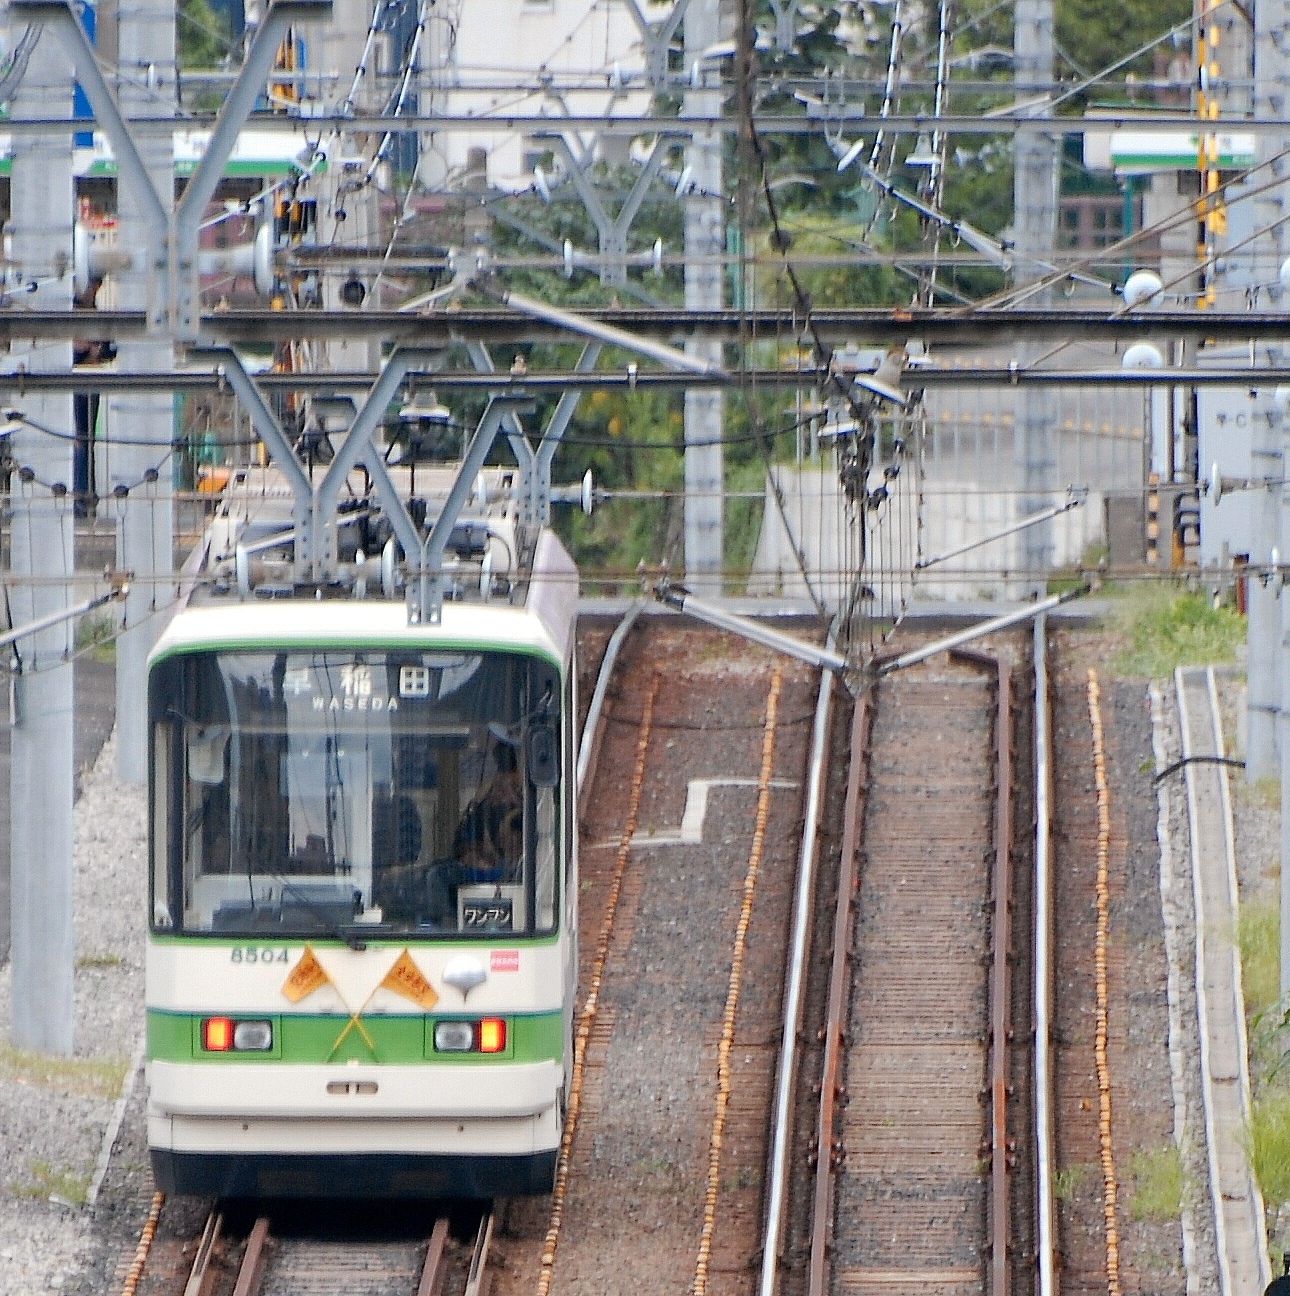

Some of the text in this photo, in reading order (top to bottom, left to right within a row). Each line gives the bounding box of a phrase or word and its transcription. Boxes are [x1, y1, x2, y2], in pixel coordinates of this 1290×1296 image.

[282, 665, 430, 696] 早稲田
[313, 697, 398, 711] WASEDA
[230, 947, 289, 963] 8504
